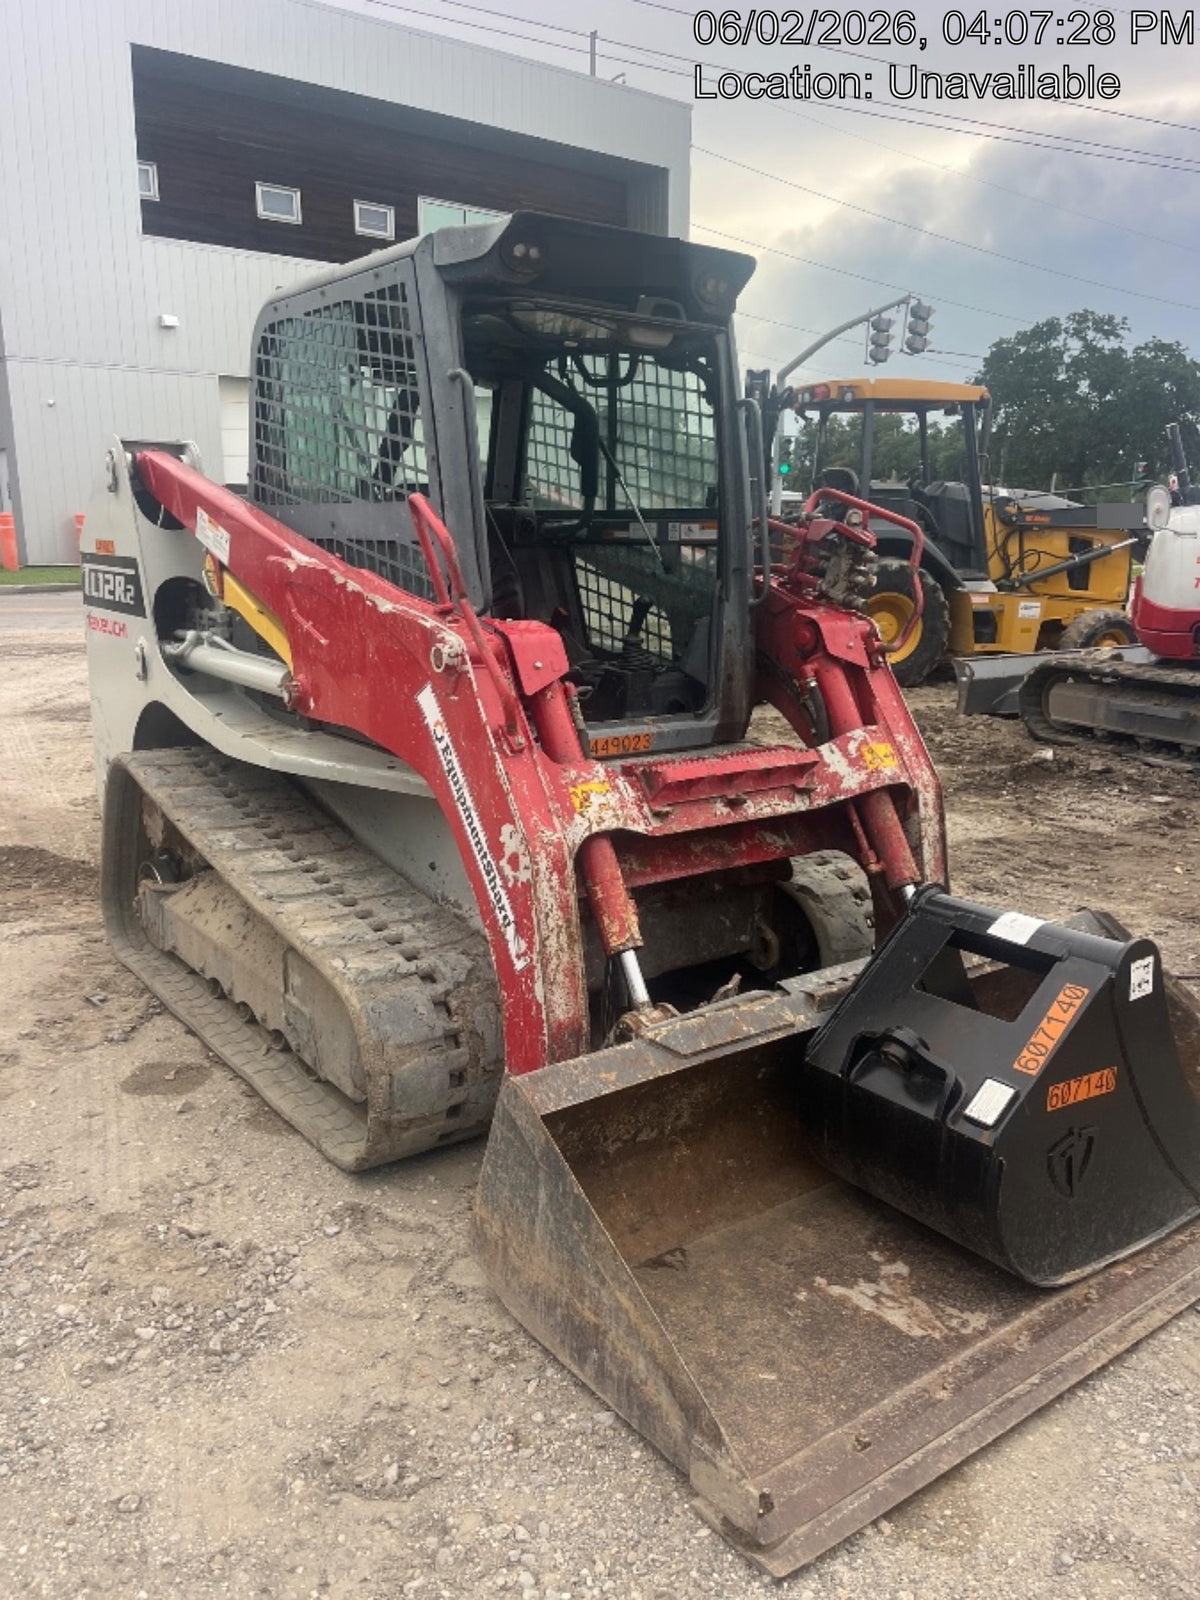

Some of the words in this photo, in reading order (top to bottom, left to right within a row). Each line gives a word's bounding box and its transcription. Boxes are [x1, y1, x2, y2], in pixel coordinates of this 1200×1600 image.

[588, 733, 652, 755] 449023
[440, 739, 515, 929] EquipmentShare
[1015, 985, 1087, 1072] 607140
[1049, 1068, 1117, 1108] 607140
